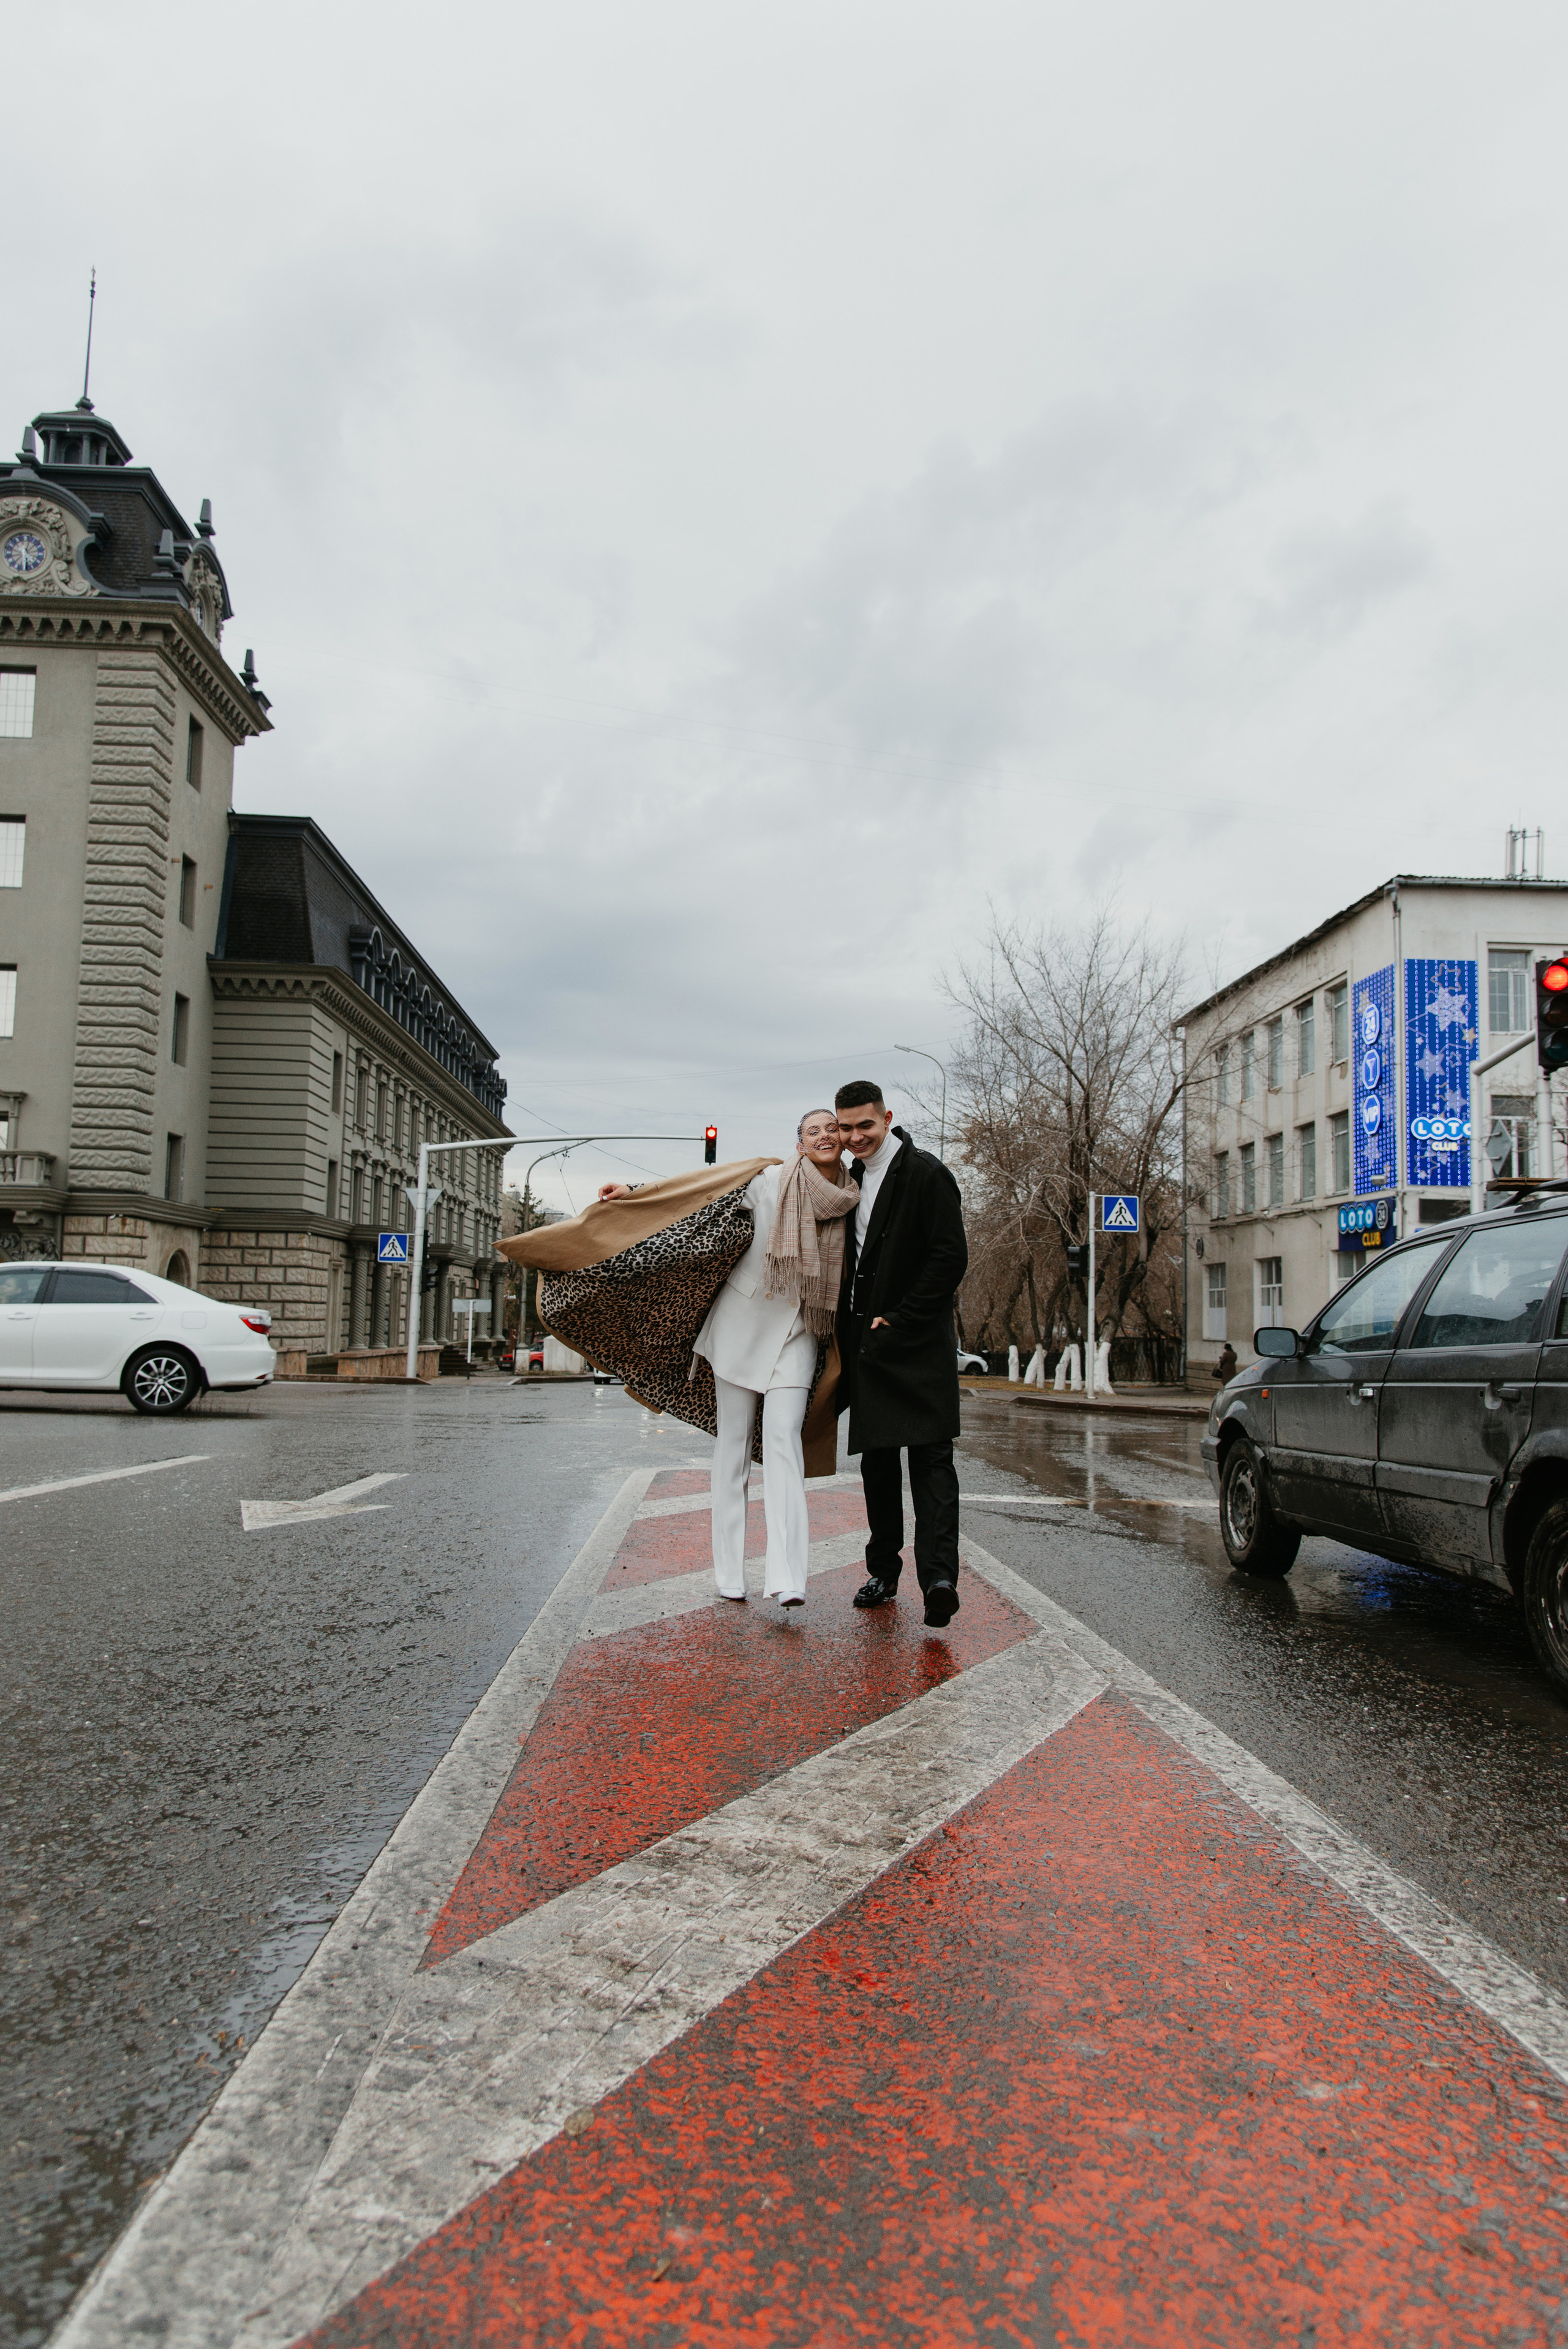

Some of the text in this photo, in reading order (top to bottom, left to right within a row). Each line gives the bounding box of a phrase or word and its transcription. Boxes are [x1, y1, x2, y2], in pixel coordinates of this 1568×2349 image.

[1364, 1105, 1378, 1124] VIP
[1431, 1141, 1458, 1151] CLUB
[1341, 1209, 1373, 1227] LOTO
[1362, 1231, 1381, 1246] CLUB
